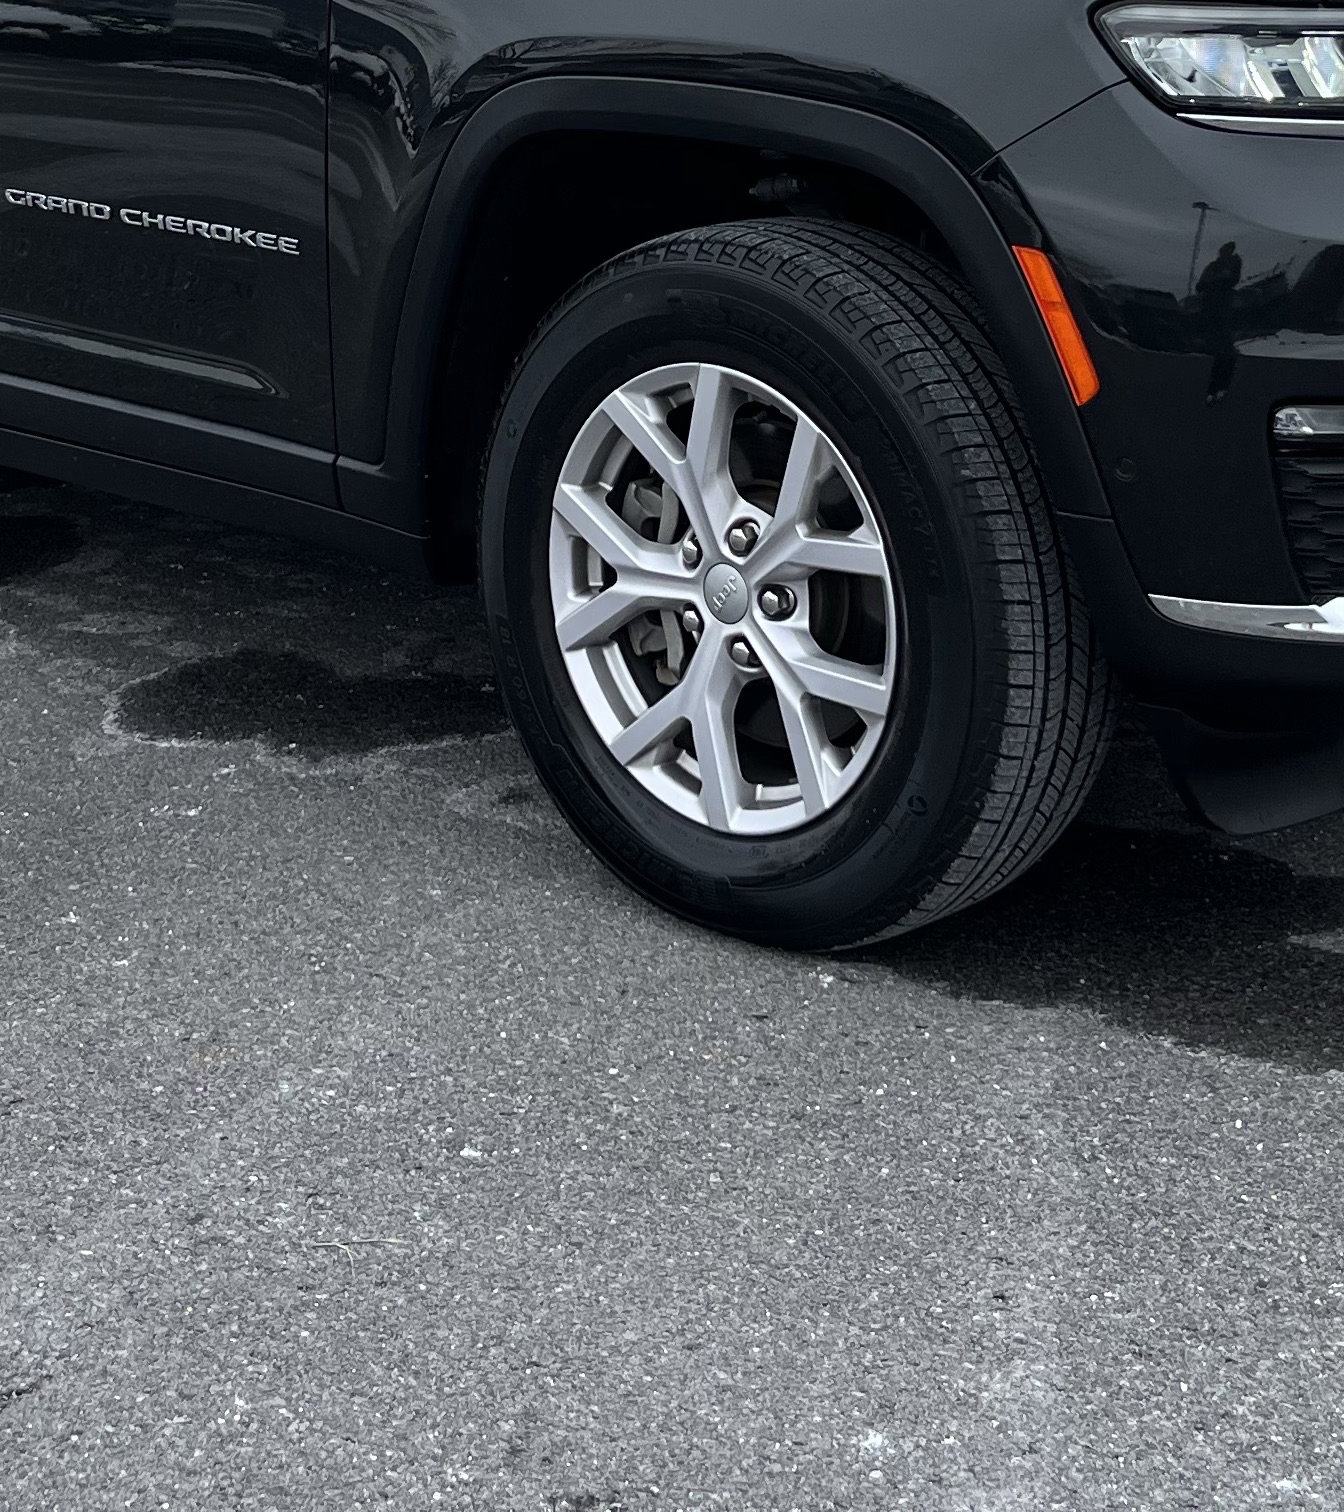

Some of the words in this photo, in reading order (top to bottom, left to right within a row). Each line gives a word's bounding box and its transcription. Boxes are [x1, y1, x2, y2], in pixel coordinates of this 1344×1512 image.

[5, 188, 110, 221] GRAND
[119, 208, 300, 256] CHEROKEE
[712, 574, 737, 611] Jeep
